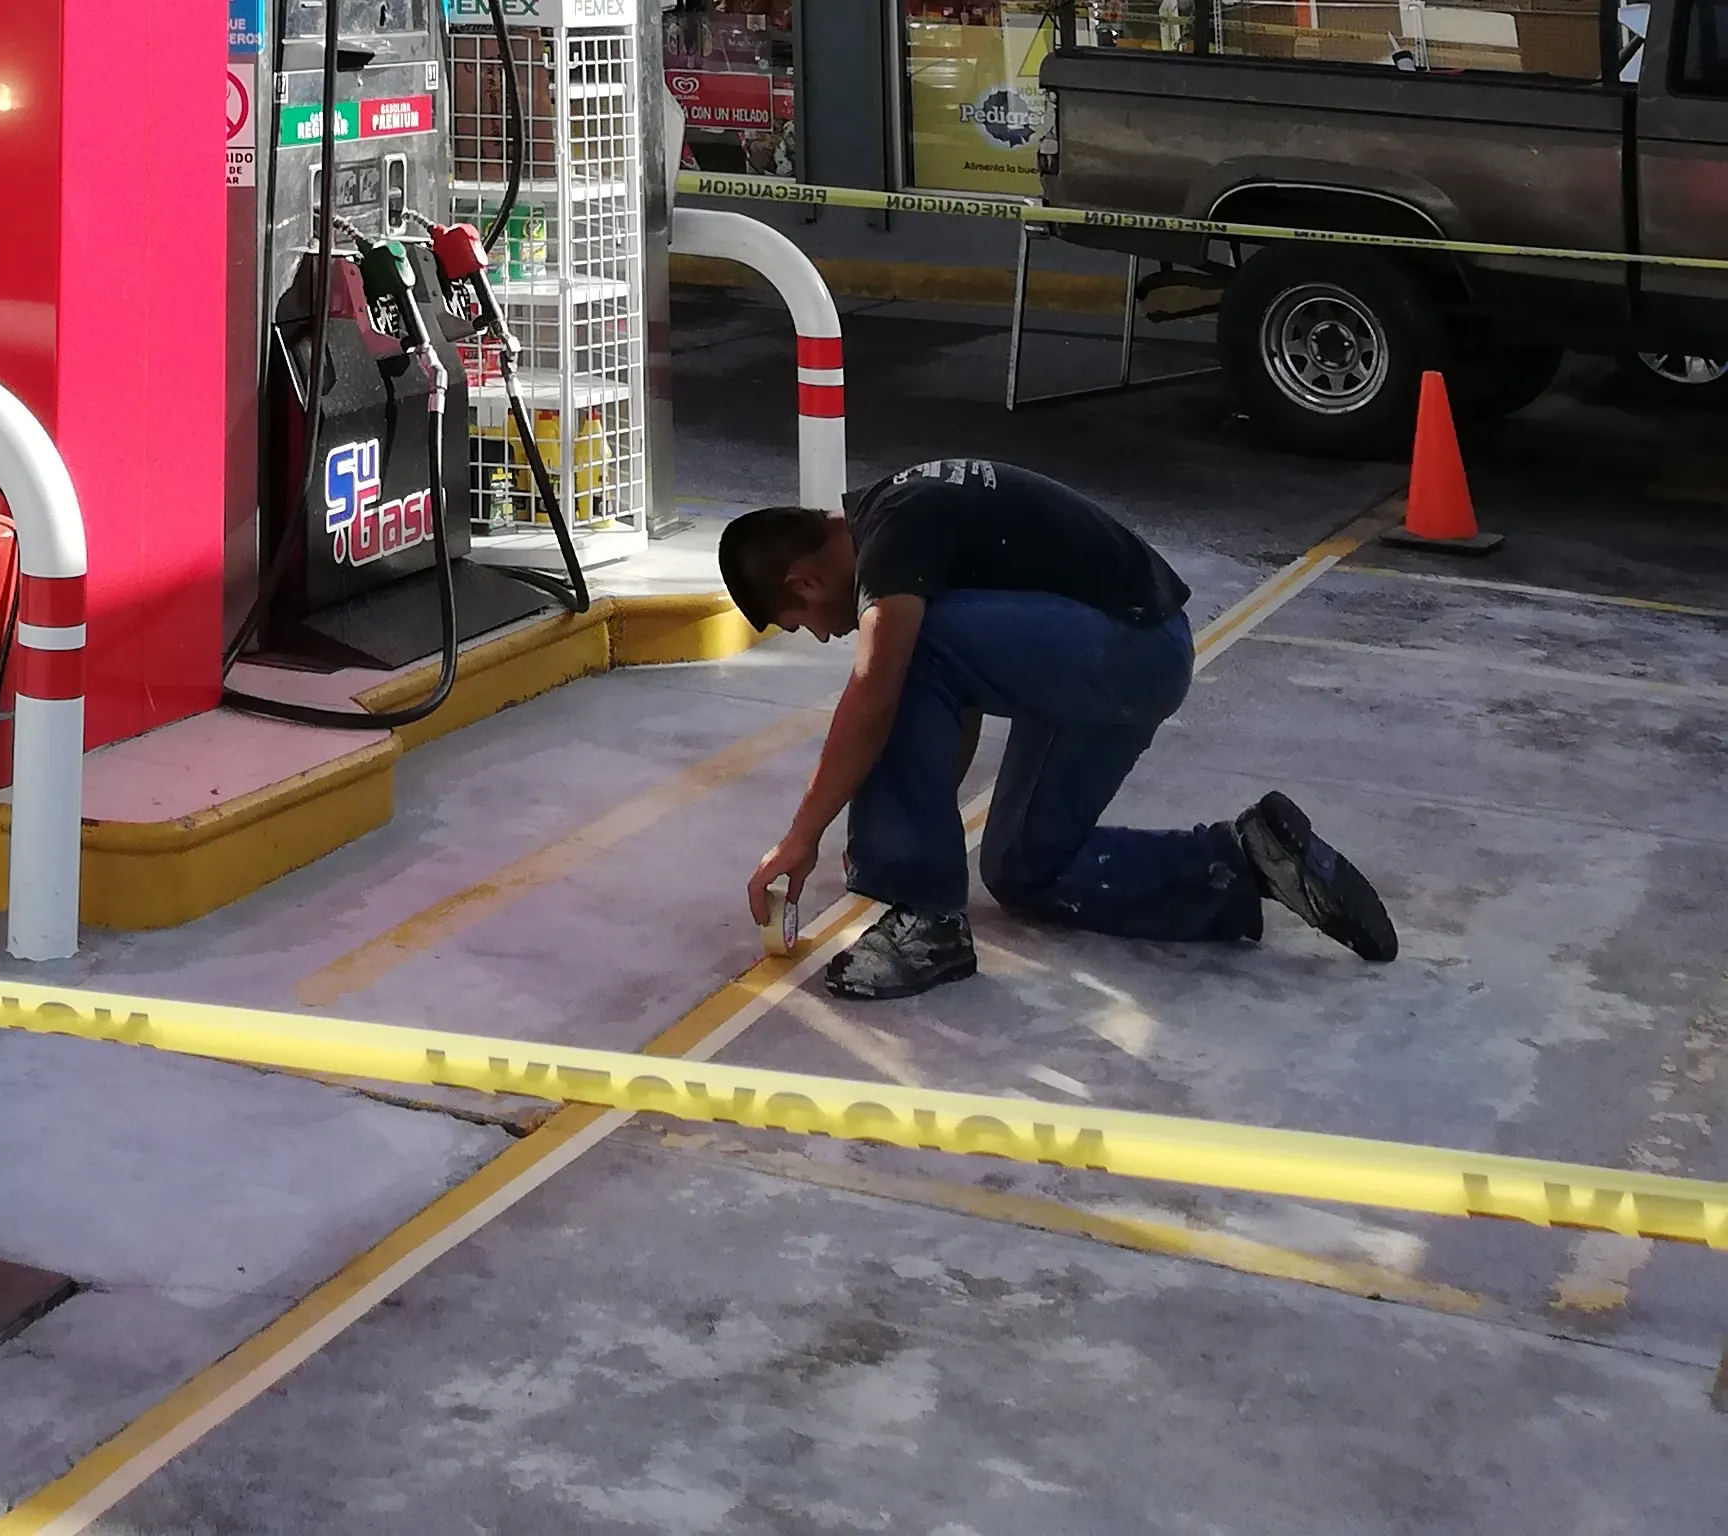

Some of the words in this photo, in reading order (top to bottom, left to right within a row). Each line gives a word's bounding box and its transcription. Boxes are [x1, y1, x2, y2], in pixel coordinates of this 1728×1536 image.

[575, 0, 625, 17] PEMEX
[372, 110, 419, 131] PREMIUM
[692, 106, 712, 120] CON
[714, 107, 729, 121] UN
[732, 108, 769, 123] HELADO
[229, 166, 243, 175] DE
